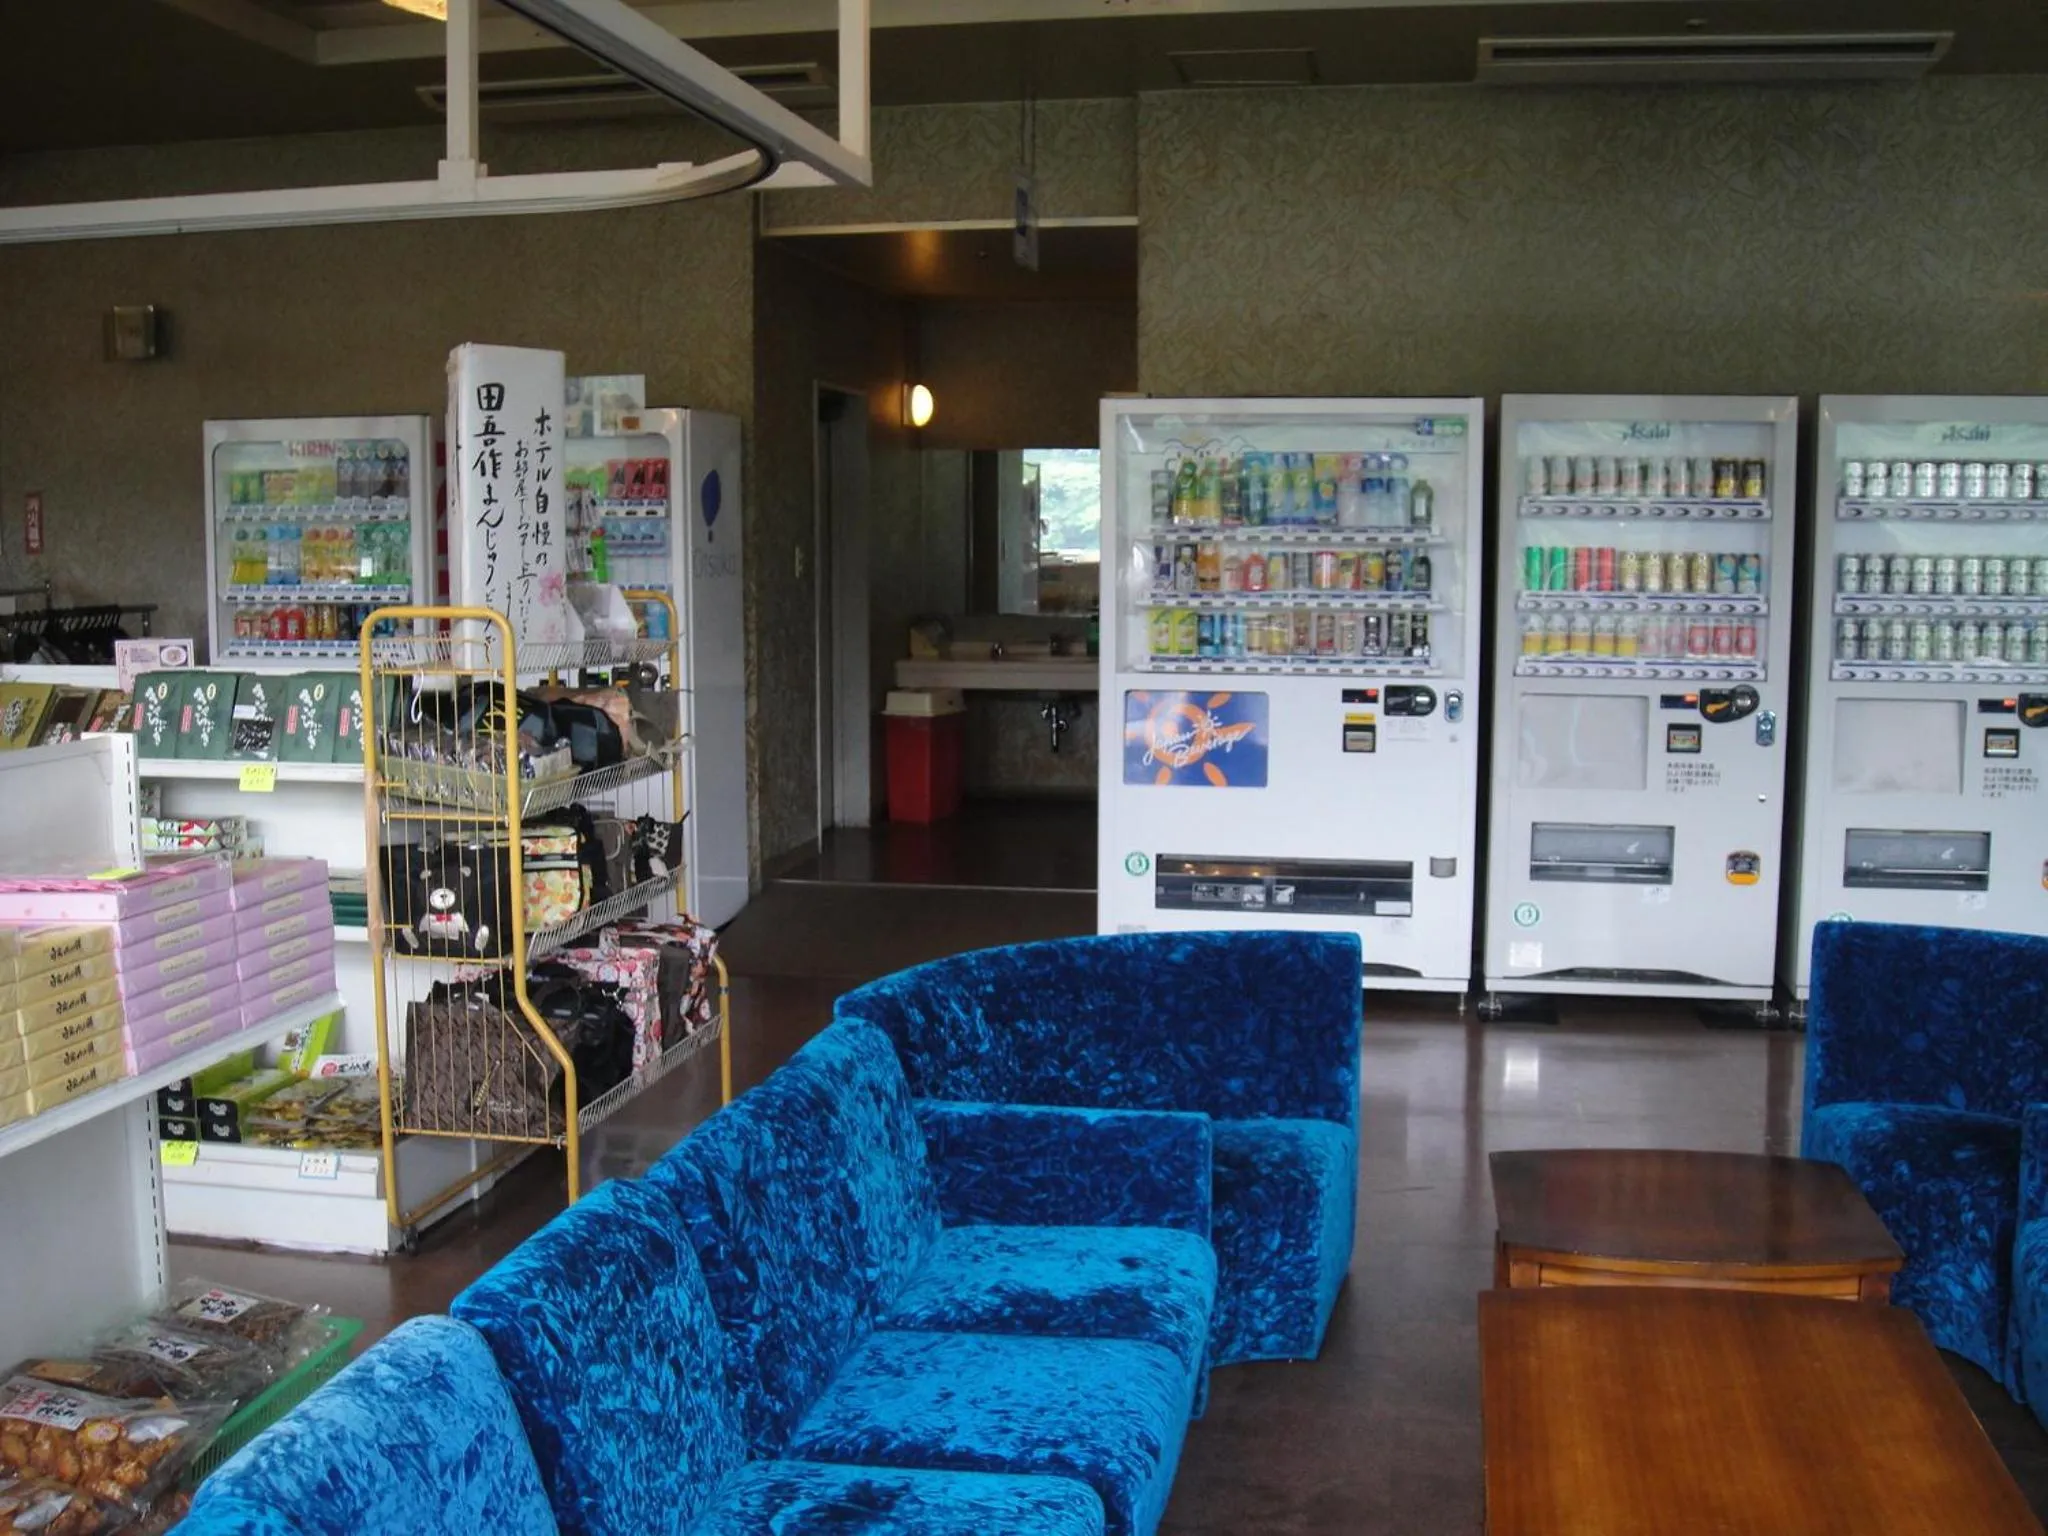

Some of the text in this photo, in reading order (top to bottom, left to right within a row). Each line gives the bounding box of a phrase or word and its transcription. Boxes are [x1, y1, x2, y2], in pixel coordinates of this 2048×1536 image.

[287, 439, 337, 457] KIRIN
[532, 407, 552, 567] ホテル自慢の
